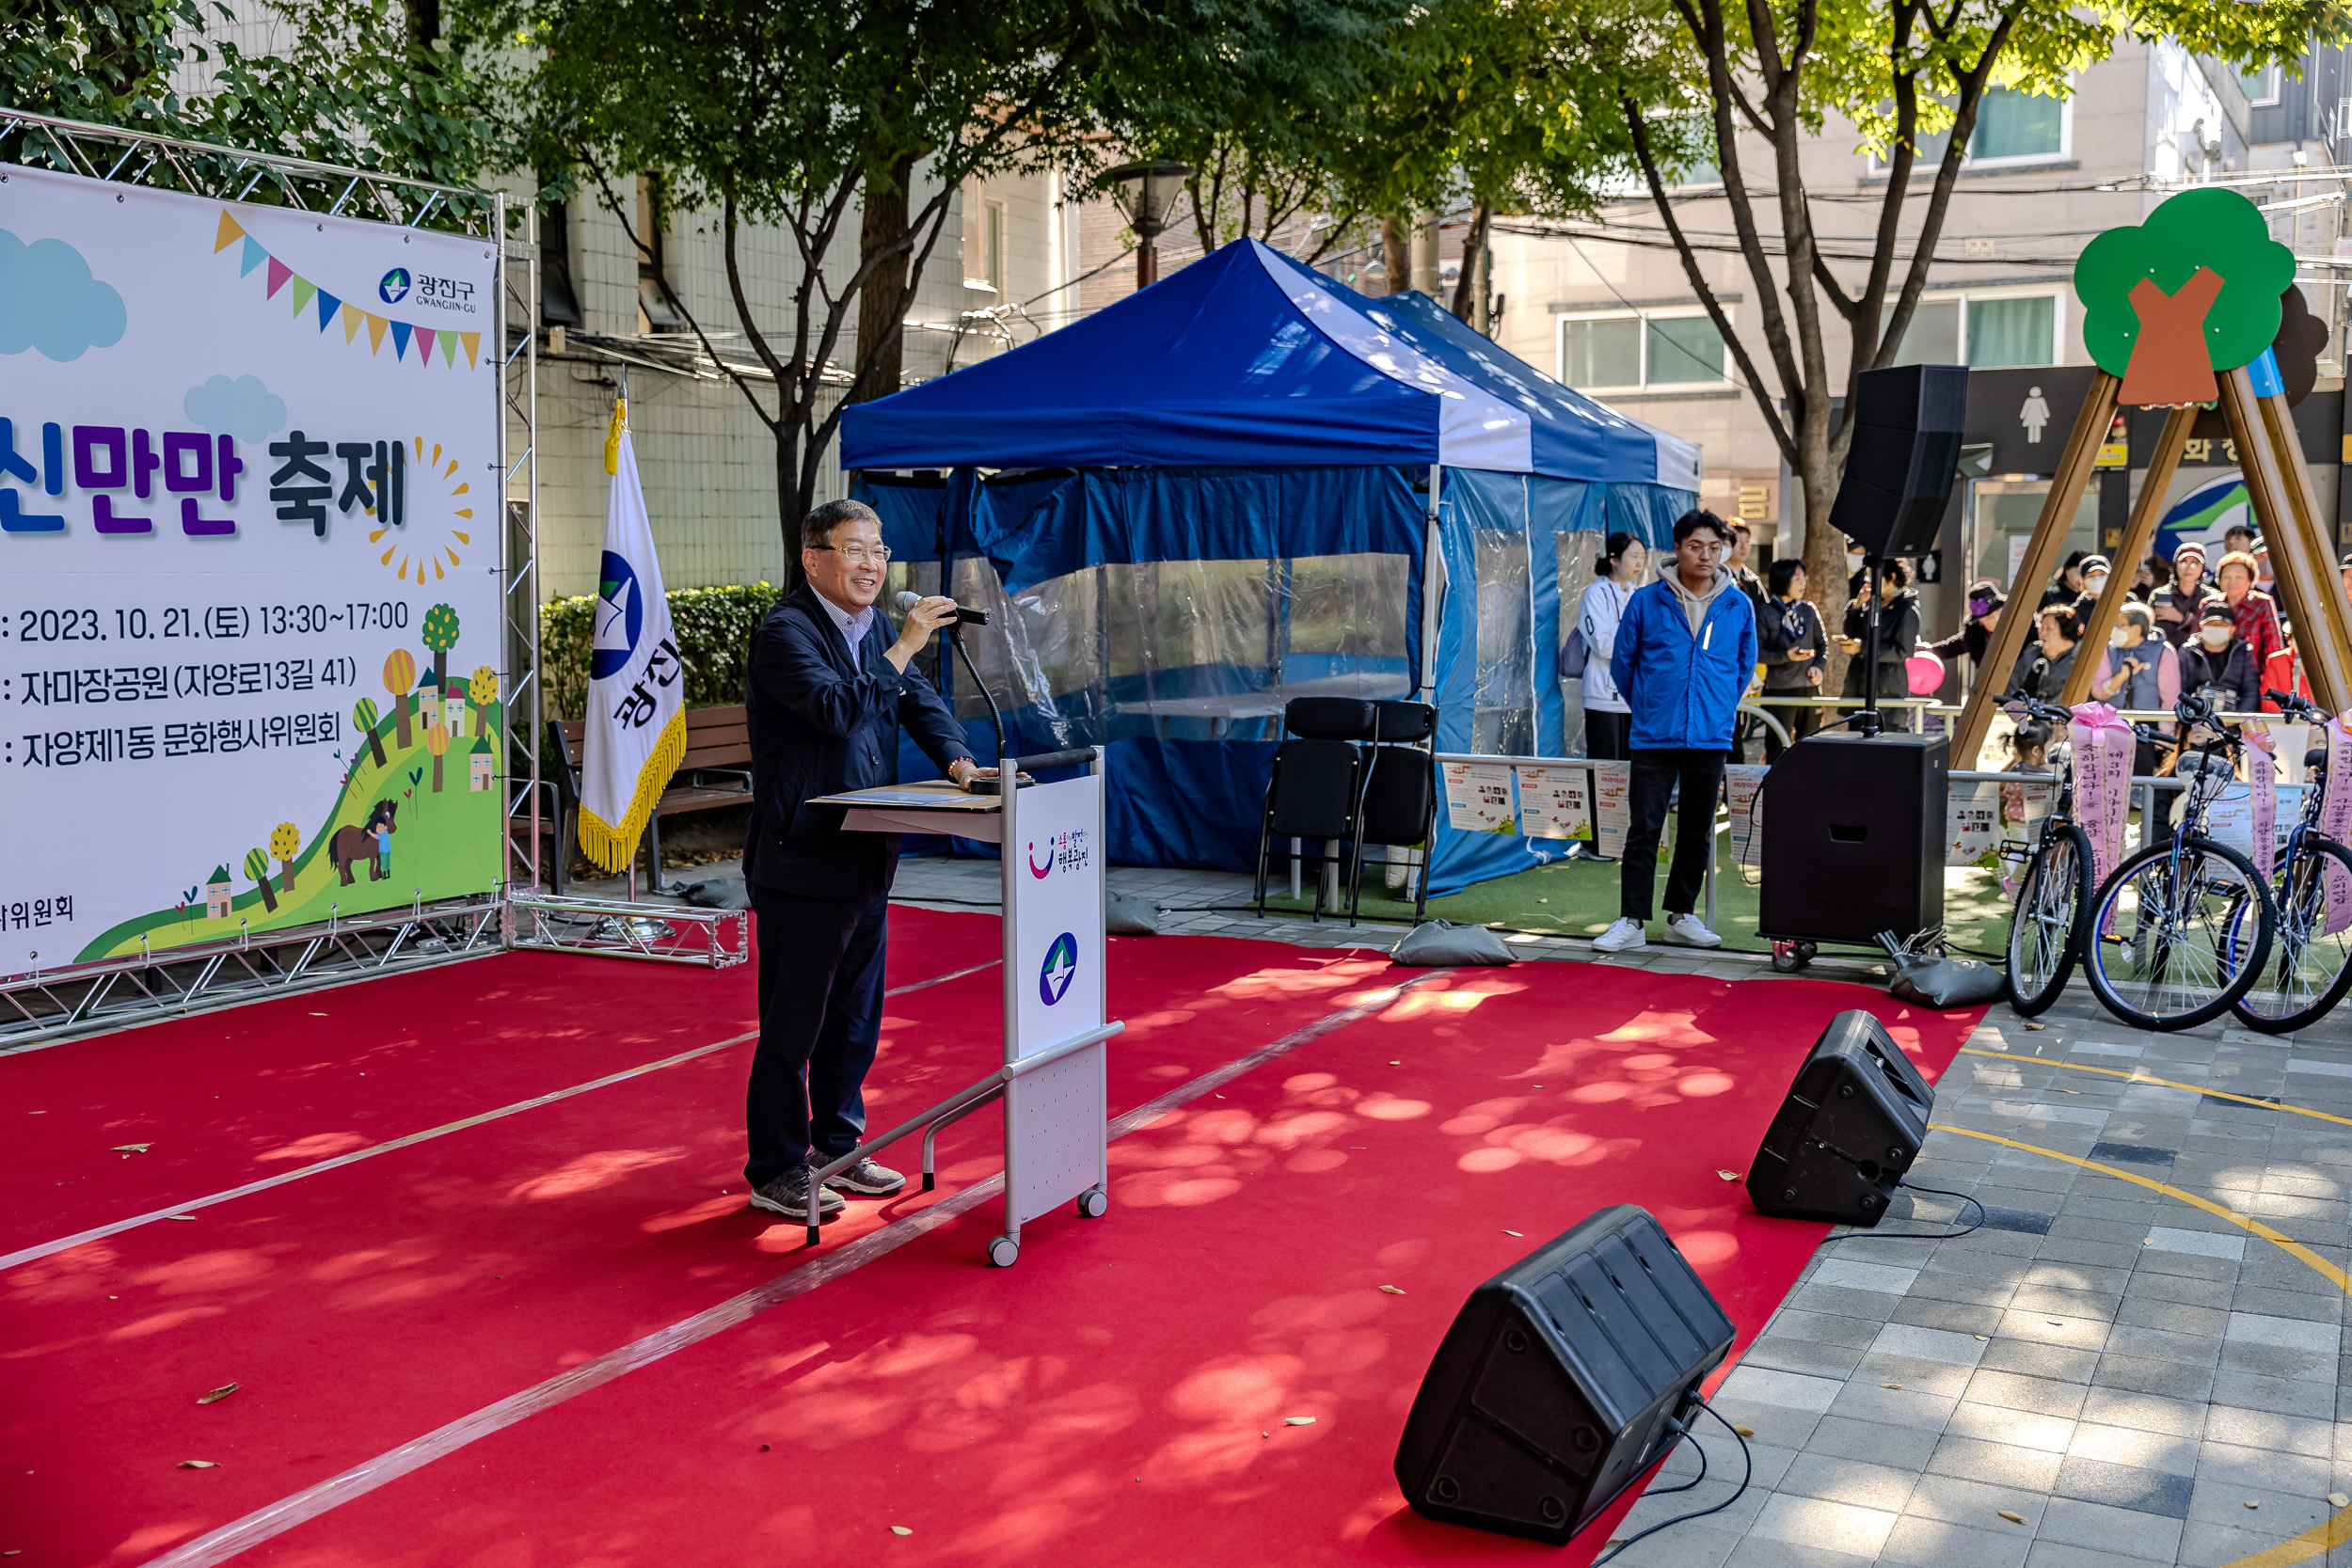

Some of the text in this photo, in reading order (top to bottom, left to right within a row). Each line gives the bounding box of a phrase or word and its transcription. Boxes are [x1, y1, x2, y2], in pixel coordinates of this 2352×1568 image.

[417, 274, 475, 301] 광진구
[416, 294, 476, 313] GWANGJIN-GU
[268, 430, 404, 537] 축제
[20, 609, 107, 641] 2023.
[115, 608, 155, 640] 10.
[261, 601, 408, 634] 13:30~17:00
[321, 656, 357, 687] 41)
[612, 625, 681, 731] 광진
[23, 725, 156, 768] 자양제1동
[163, 711, 341, 758] 문화행사위원회
[1058, 847, 1088, 873] 행복광진
[1809, 898, 1899, 919] STRATOS
